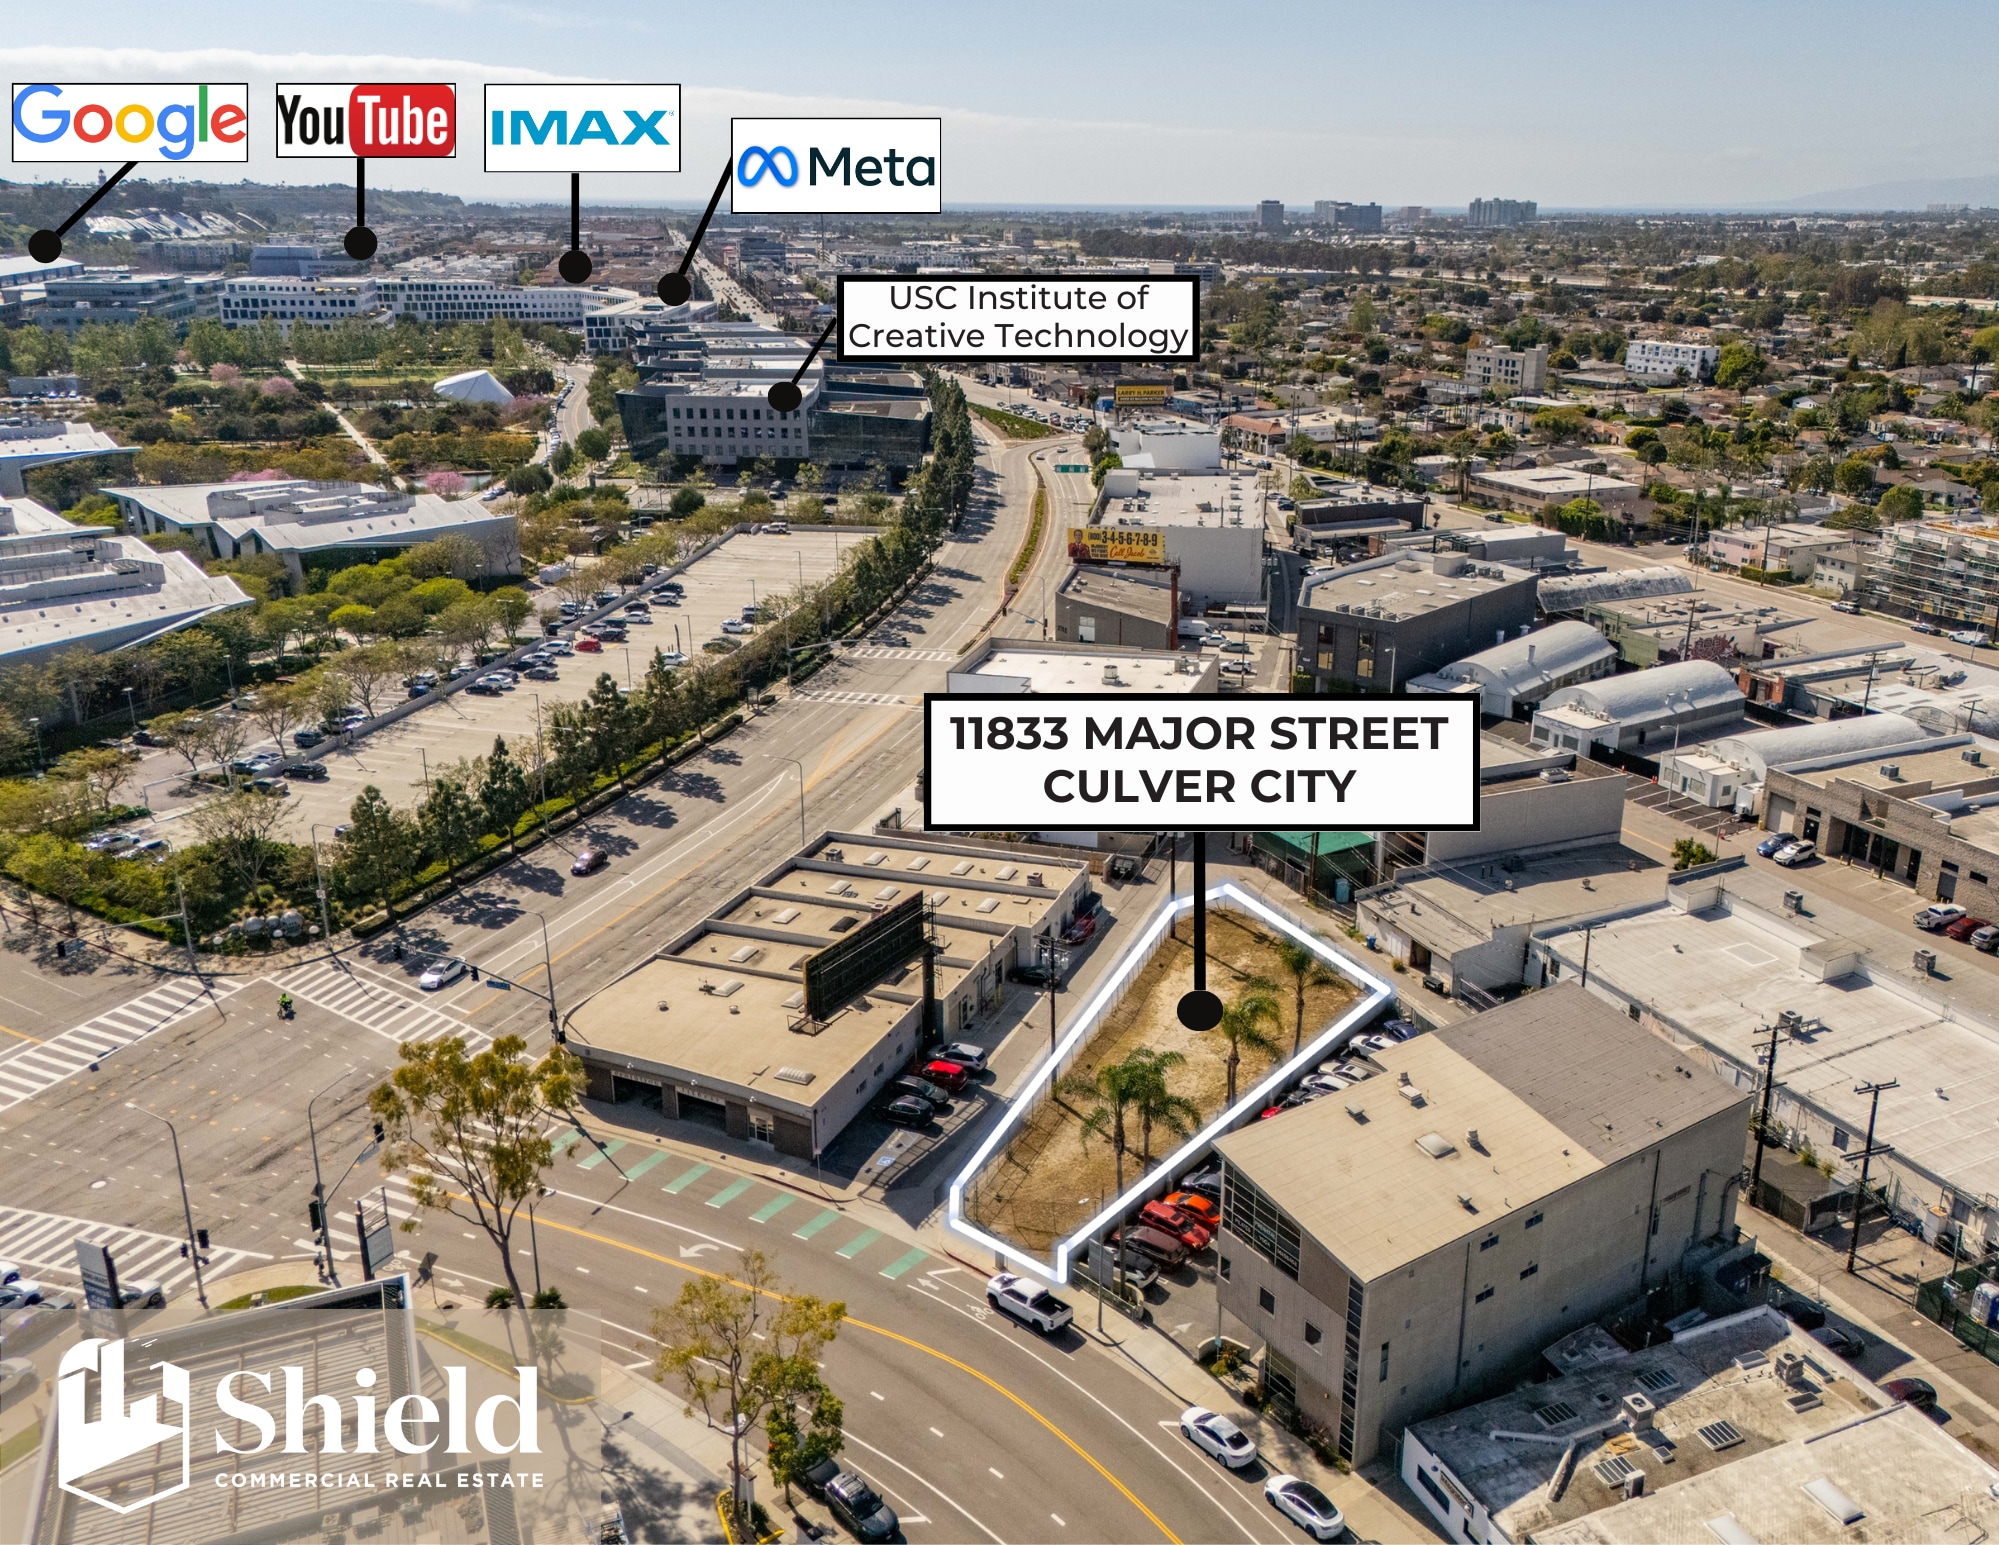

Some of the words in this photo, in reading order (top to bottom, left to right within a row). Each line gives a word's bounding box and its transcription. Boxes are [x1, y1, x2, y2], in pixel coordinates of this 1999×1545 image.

[1109, 545, 1123, 558] Call
[1124, 546, 1145, 559] Jacob
[91, 1294, 107, 1305] CAR
